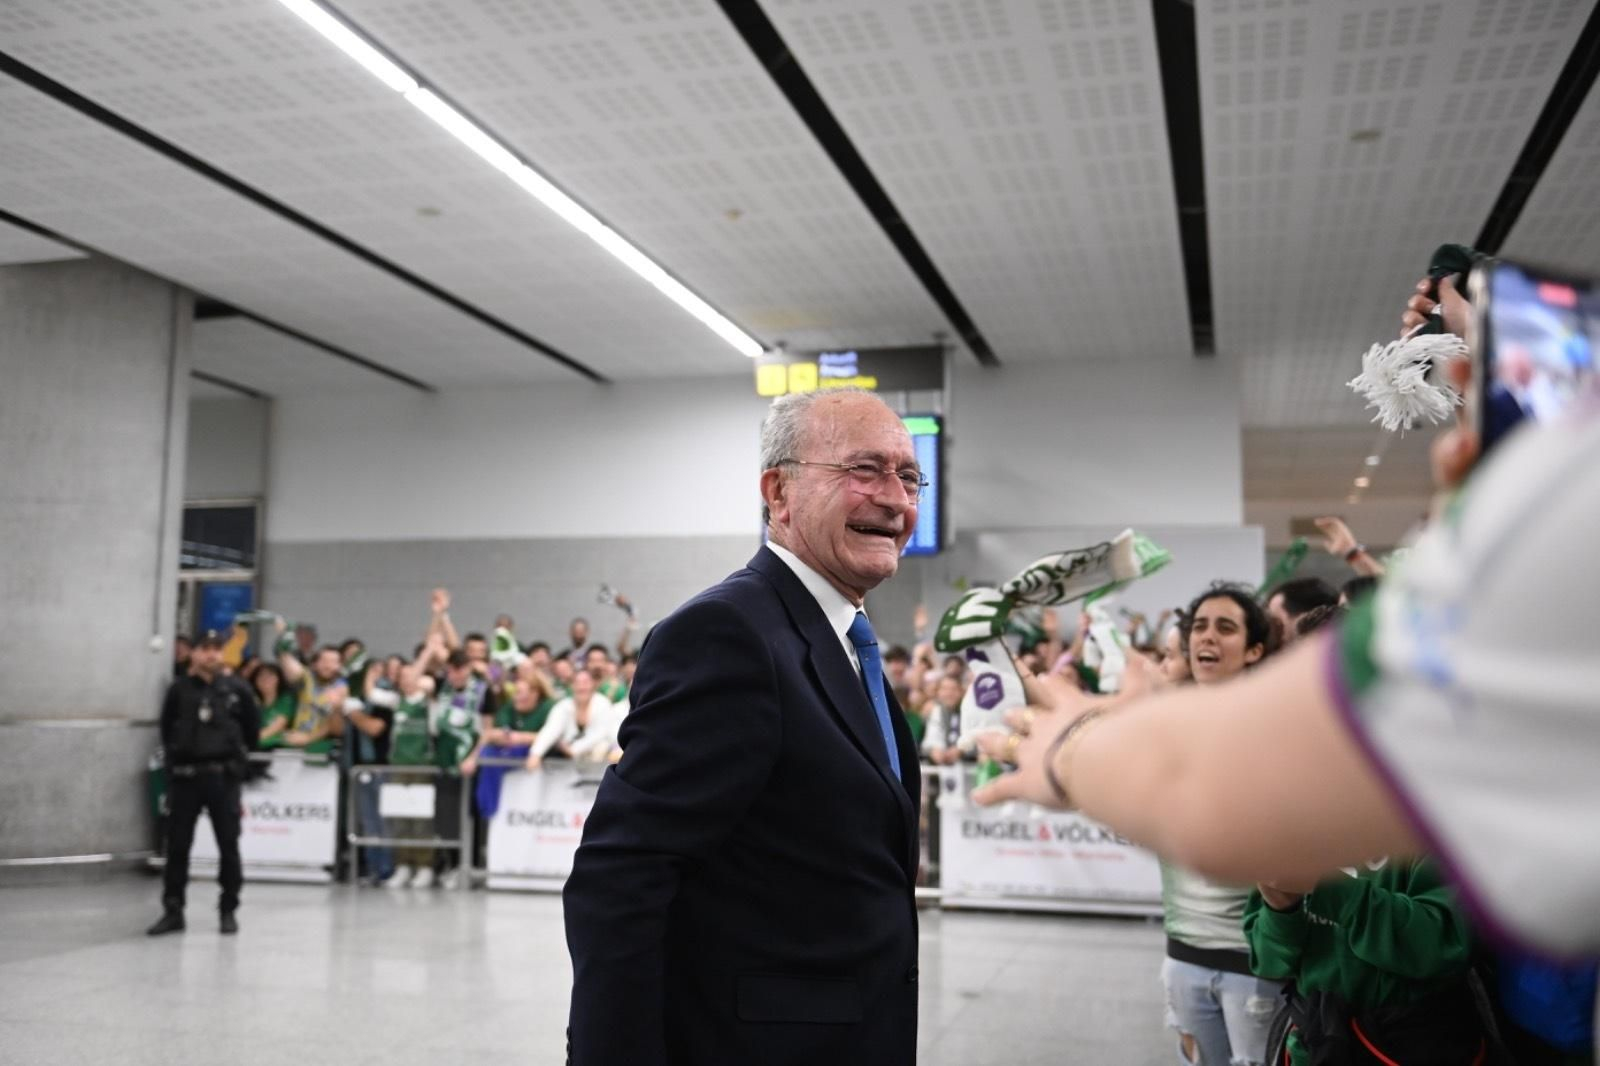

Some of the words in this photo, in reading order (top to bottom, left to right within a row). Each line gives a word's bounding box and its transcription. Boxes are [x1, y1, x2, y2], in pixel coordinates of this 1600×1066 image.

[250, 802, 331, 820] VÖLKERS
[507, 811, 568, 827] ENGEL
[962, 820, 1033, 840] ENGEL
